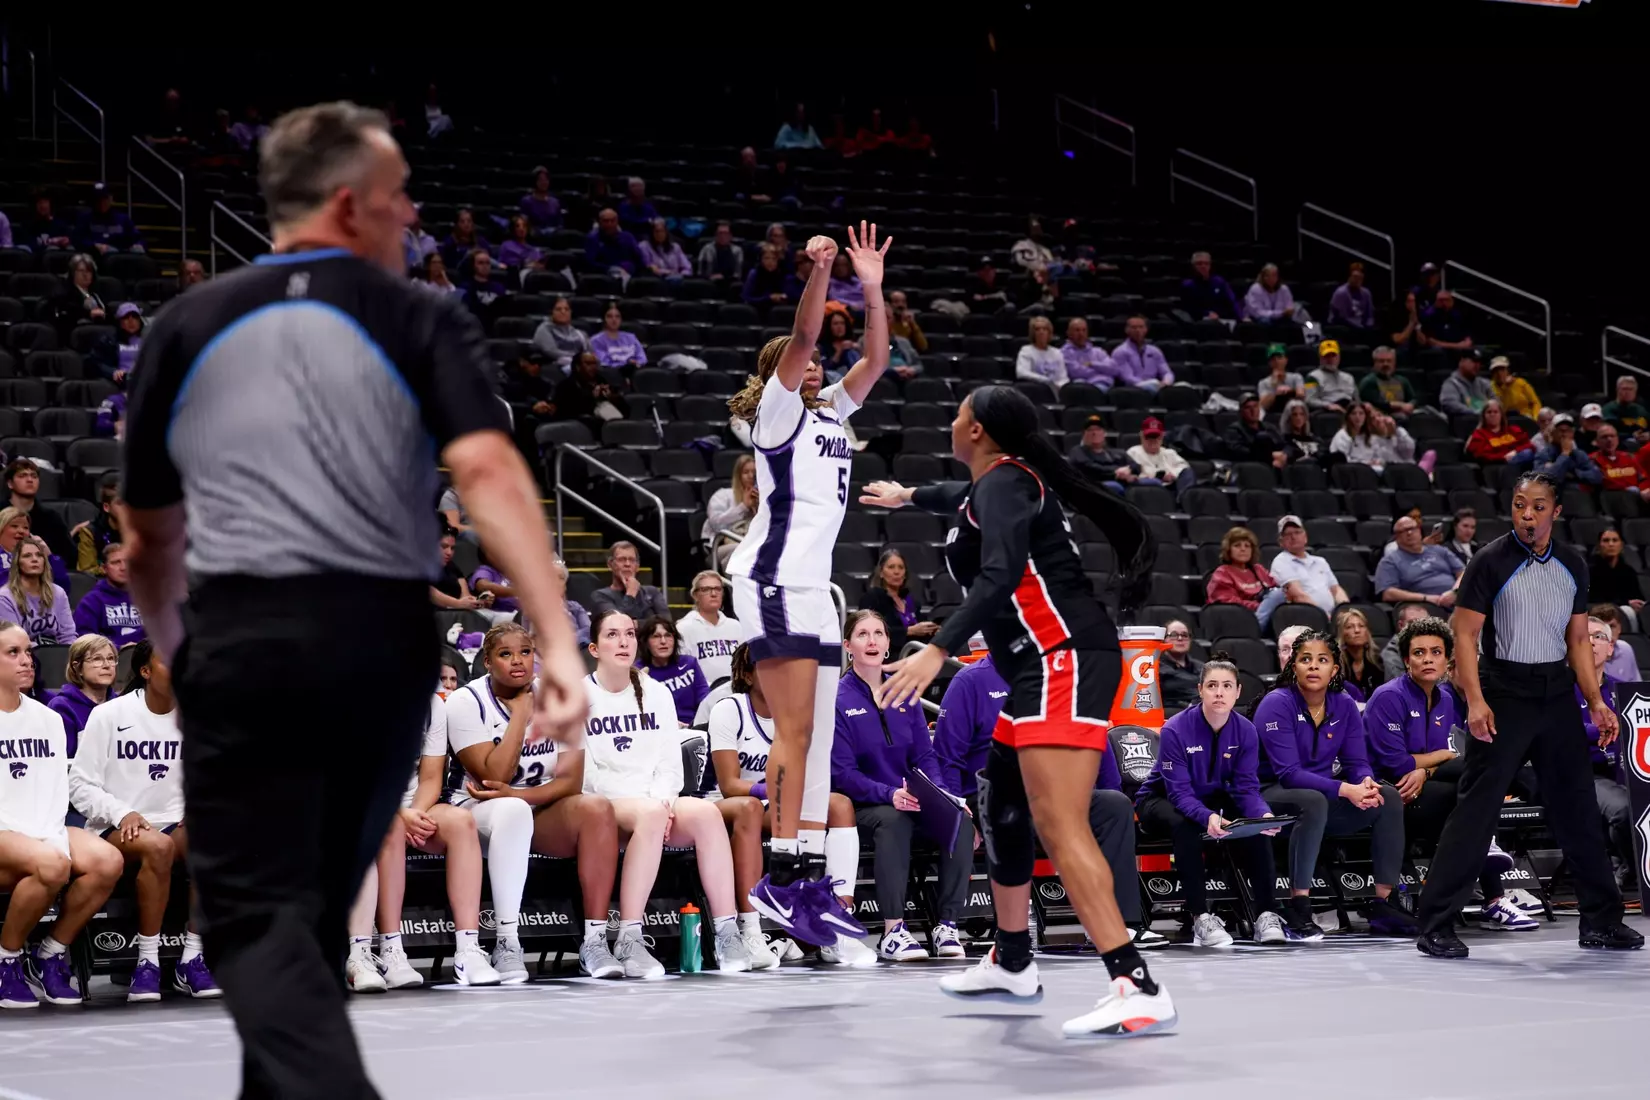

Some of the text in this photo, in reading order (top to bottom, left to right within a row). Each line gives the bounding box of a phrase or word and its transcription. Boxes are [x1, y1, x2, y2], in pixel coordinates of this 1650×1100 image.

[815, 435, 852, 460] Wildc
[837, 467, 847, 506] 5
[1131, 655, 1155, 684] G
[585, 715, 623, 736] LOCK
[624, 714, 637, 732] IT
[0, 739, 18, 759] CK
[19, 739, 33, 758] IT
[117, 740, 161, 760] LOCK
[164, 741, 179, 760] IT
[1500, 868, 1531, 881] state
[517, 911, 570, 926] llstate
